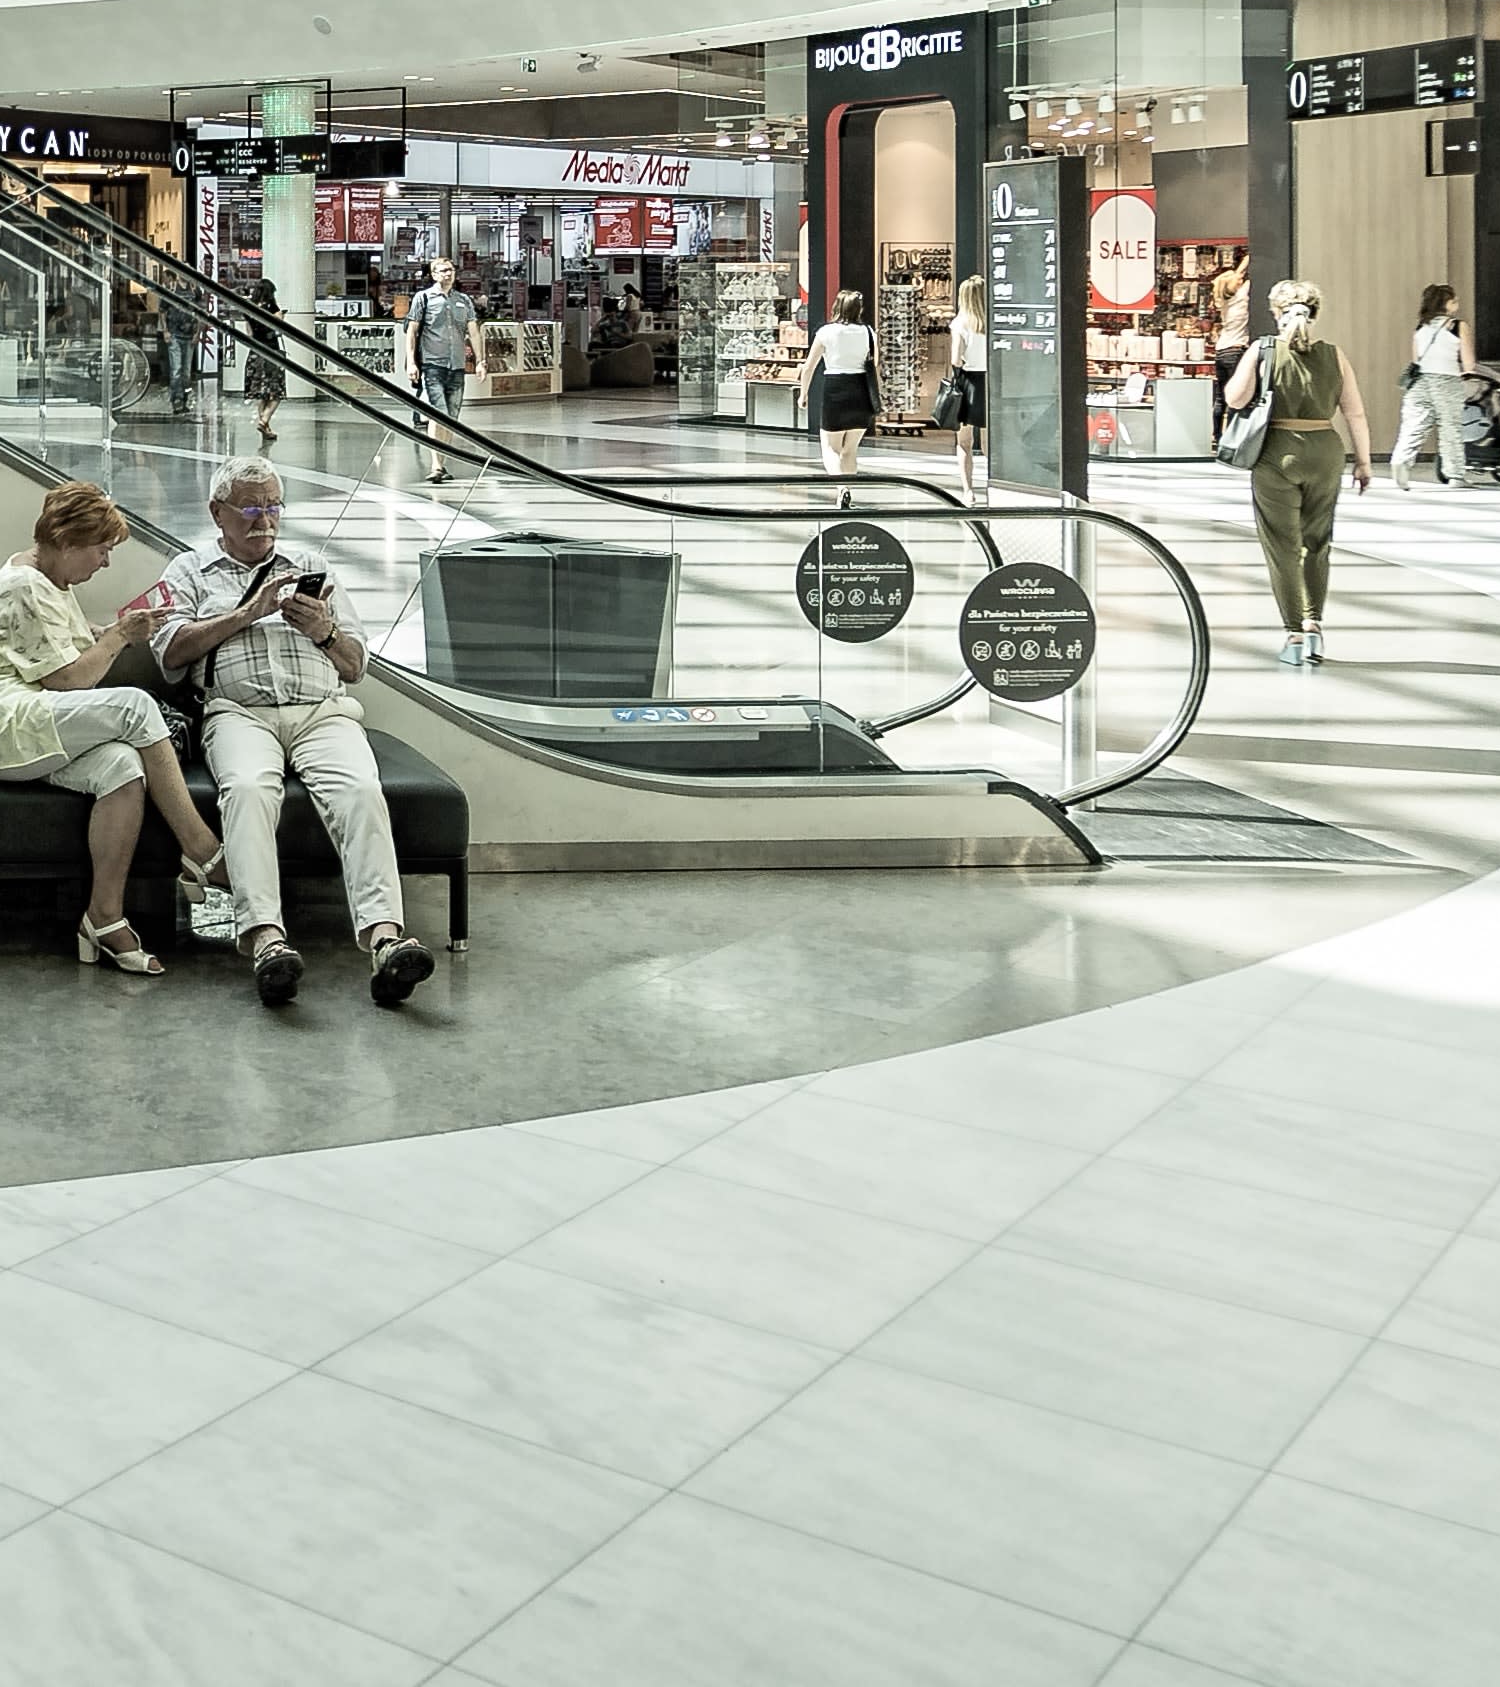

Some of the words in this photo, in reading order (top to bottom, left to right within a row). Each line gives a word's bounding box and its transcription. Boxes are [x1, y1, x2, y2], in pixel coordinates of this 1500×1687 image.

[1290, 71, 1307, 108] 0
[134, 150, 173, 162] POKOLE
[175, 147, 189, 172] 0
[238, 148, 253, 156] CCC
[562, 150, 623, 184] Media
[637, 154, 691, 187] Markt
[1099, 240, 1148, 260] SALE
[830, 574, 841, 582] for
[841, 576, 858, 584] your
[859, 574, 881, 584] safety
[999, 623, 1011, 632] for
[1011, 625, 1032, 635] your
[1032, 622, 1058, 634] safety
